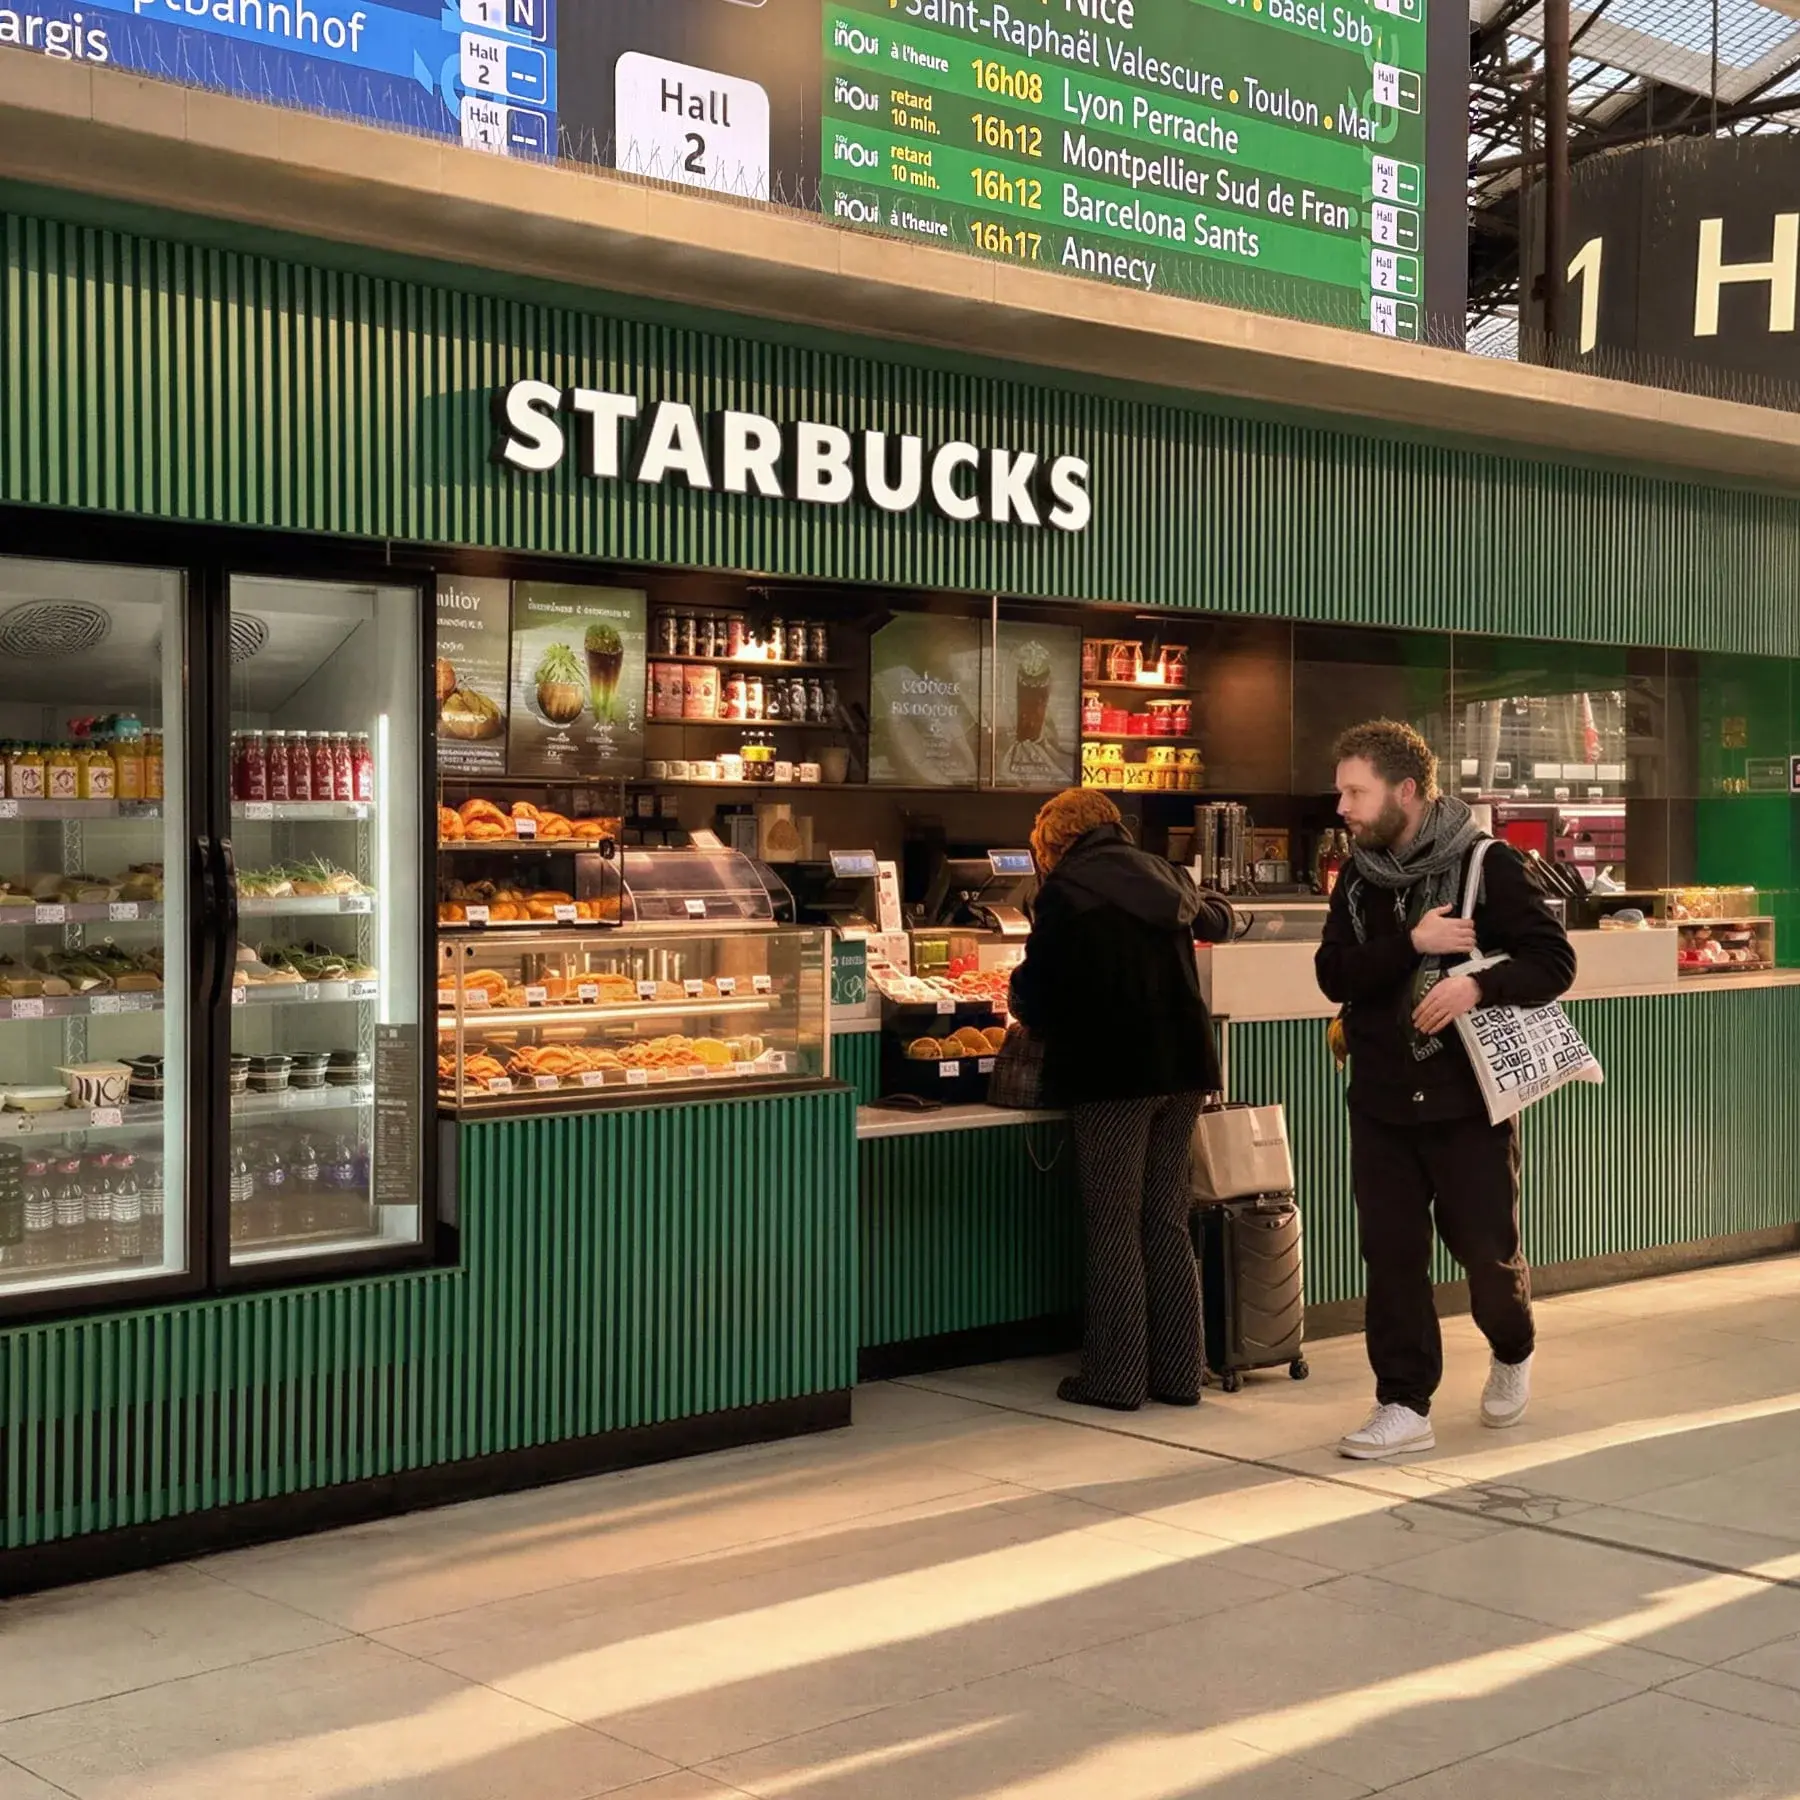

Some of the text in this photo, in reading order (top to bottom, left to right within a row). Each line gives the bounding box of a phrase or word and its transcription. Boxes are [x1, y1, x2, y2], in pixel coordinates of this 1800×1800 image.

[478, 2, 488, 22] 1
[1333, 7, 1373, 46] Sbb
[469, 41, 499, 63] Hall
[890, 41, 899, 60] à
[477, 64, 490, 86] 2
[971, 57, 1043, 104] 16h08
[1378, 69, 1394, 84] Hall
[890, 88, 933, 112] retard
[1105, 36, 1224, 102] Valescure
[1243, 76, 1318, 127] Toulon
[1338, 104, 1380, 143] Mar
[1383, 86, 1389, 101] 1
[661, 77, 731, 128] Hall
[1063, 77, 1239, 152] Lyon Perrache
[470, 106, 500, 127] Hall
[891, 108, 941, 135] 10 min.
[971, 113, 1043, 158] 16h12
[684, 132, 706, 175] 2
[890, 144, 933, 167] retard
[891, 163, 941, 191] 10 min.
[1062, 130, 1349, 230] Montpellier Sud de Fran
[1377, 163, 1394, 177] Hall
[970, 167, 1042, 211] 16h12
[1381, 179, 1389, 194] 2
[890, 210, 899, 226] à
[1062, 183, 1260, 258] Barcelona Sants
[1376, 210, 1393, 223] Hall
[970, 221, 1042, 260] 16h17
[1381, 225, 1388, 241] 2
[1061, 236, 1157, 290] Annecy
[1376, 256, 1392, 270] Hall
[1380, 272, 1388, 286] 2
[1567, 212, 1800, 355] 1 H
[1375, 301, 1392, 316] Hall
[503, 379, 1092, 532] STARBUCKS
